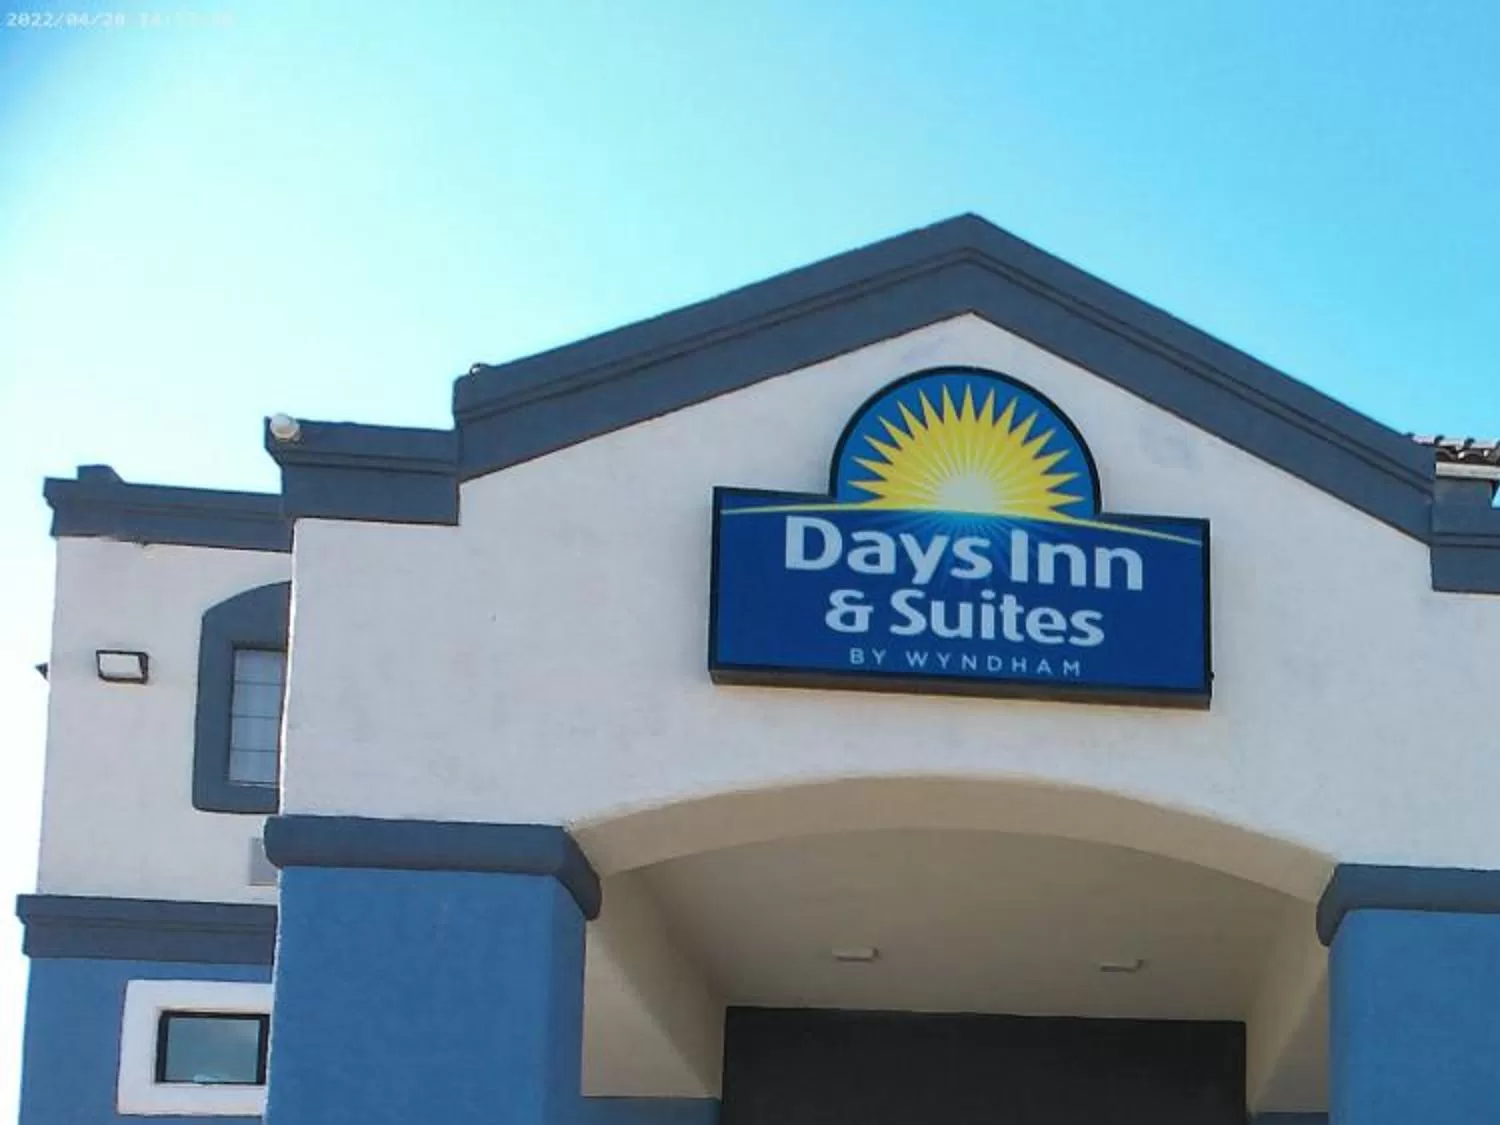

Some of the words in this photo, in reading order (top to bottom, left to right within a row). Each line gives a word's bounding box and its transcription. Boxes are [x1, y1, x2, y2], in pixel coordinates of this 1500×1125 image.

[785, 515, 993, 585] Days
[1011, 529, 1144, 591] Inn
[825, 589, 873, 633] &
[889, 589, 1105, 647] Suites
[850, 648, 887, 666] BY
[905, 651, 1081, 677] WYNDHAM
